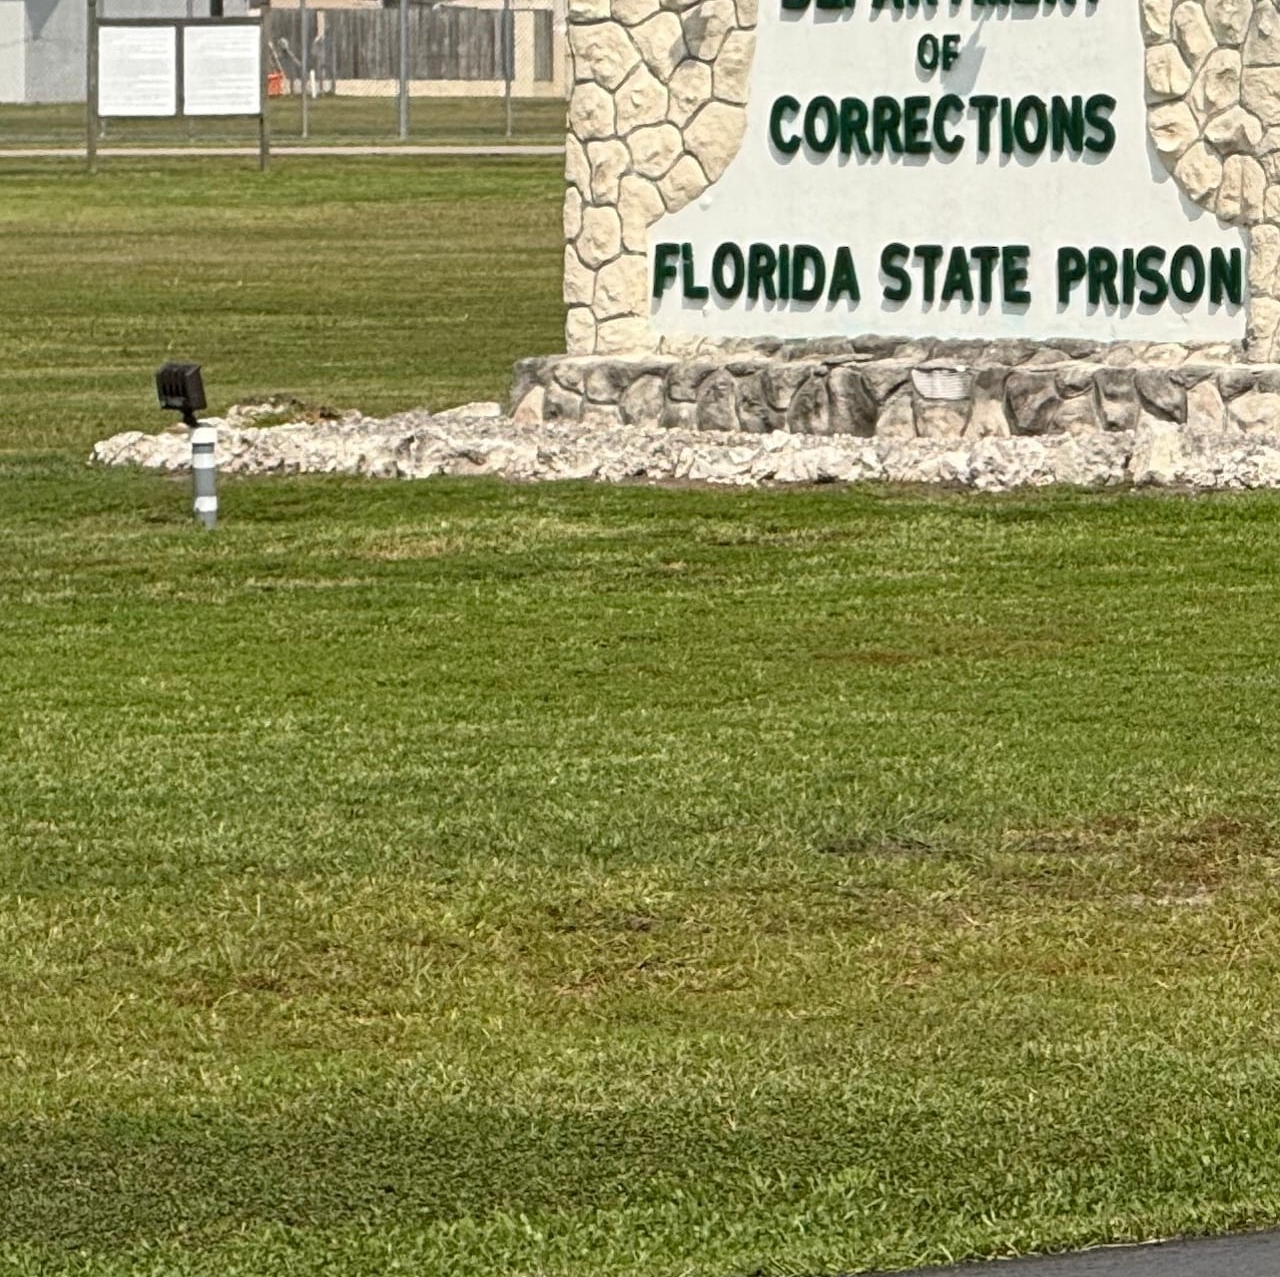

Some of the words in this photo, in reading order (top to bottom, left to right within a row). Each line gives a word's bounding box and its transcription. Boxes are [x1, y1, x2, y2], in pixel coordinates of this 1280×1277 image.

[916, 33, 961, 71] OF
[769, 94, 1117, 156] CORRECTIONS
[652, 241, 860, 301] FLORIDA
[880, 242, 1031, 303] STATE
[1056, 244, 1243, 305] PRISON
